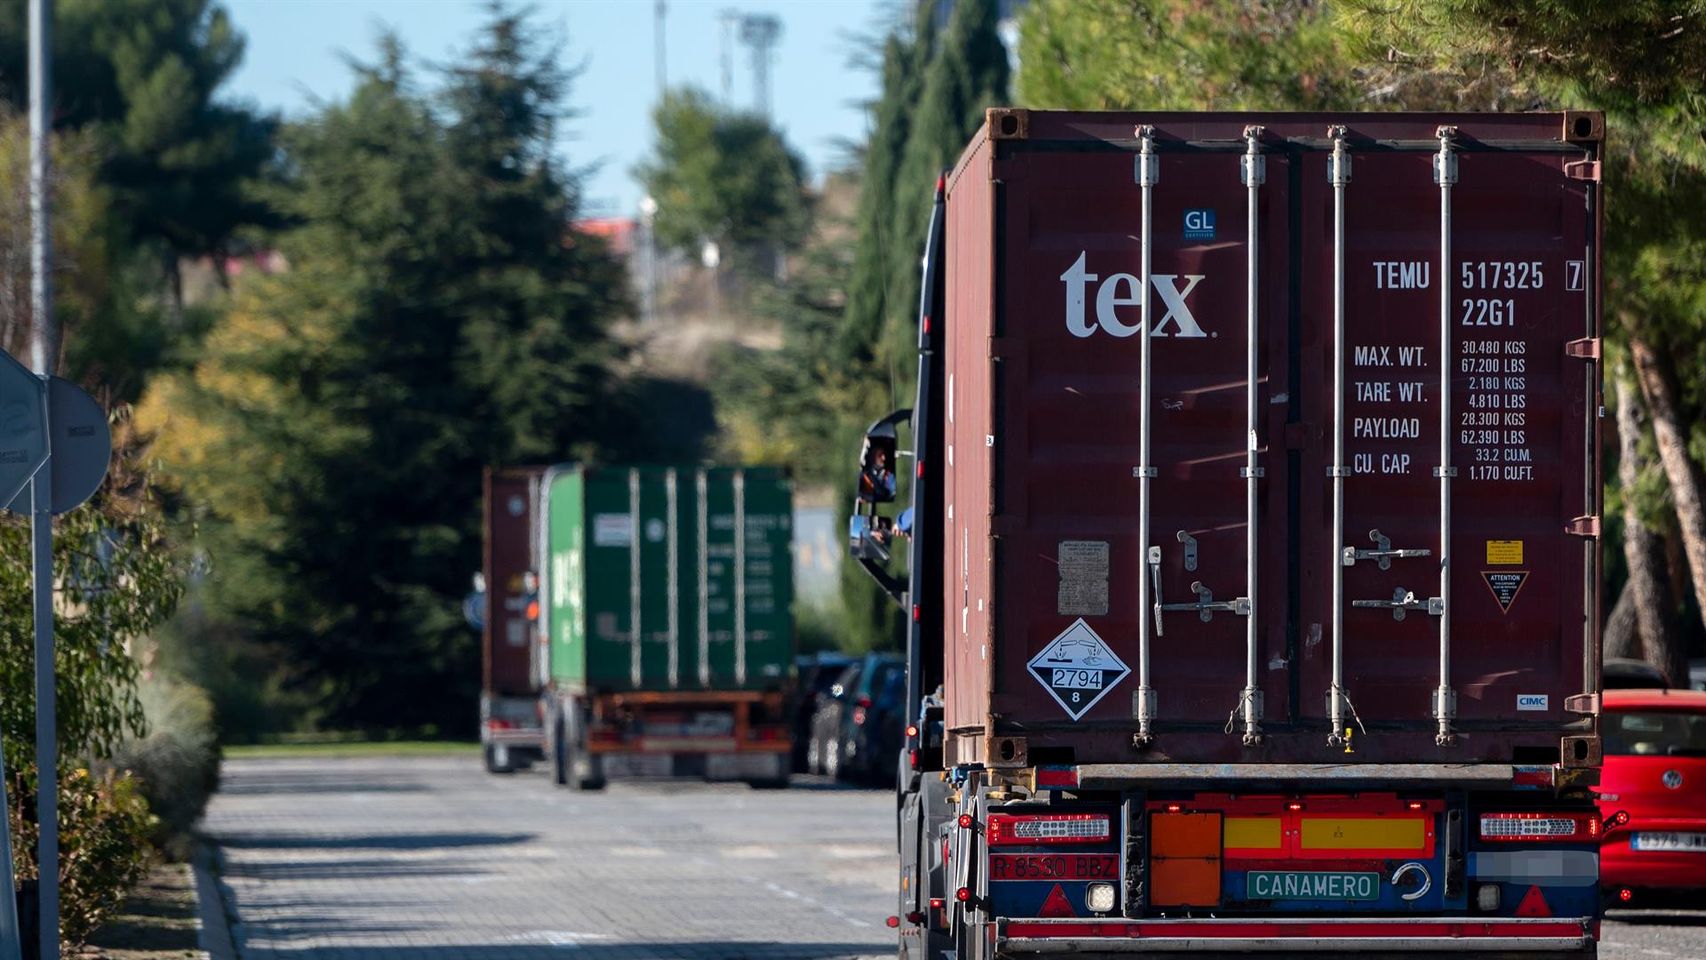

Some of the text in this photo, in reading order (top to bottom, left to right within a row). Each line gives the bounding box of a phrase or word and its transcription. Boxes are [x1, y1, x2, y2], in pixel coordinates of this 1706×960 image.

[1185, 211, 1214, 229] GL
[1373, 261, 1581, 290] TEMU 517325 7
[1461, 298, 1515, 326] 22G1
[1461, 340, 1526, 354] 30.480 KGS
[1354, 346, 1428, 367] MAX. WT.
[1461, 358, 1525, 373] 67.200 LBS
[1468, 377, 1526, 390] 2.180 KGS
[1355, 382, 1428, 402] TARE WT.
[1468, 394, 1526, 408] 4.810 LBS
[1461, 412, 1526, 426] 28.300 KGS
[1354, 418, 1420, 438] PAYLOAD
[1461, 430, 1525, 444] 62.390 LBS
[1475, 448, 1532, 462] 33.2 CU.M.
[1354, 453, 1410, 474] CU. CAP.
[1469, 466, 1534, 481] 1.170 CU.FT.
[1053, 669, 1101, 688] 2794
[1071, 691, 1080, 703] 8
[1519, 697, 1546, 706] CIMC
[993, 857, 1007, 878] R
[1014, 857, 1067, 878] 8530
[1255, 873, 1371, 897] CAÑAMERO
